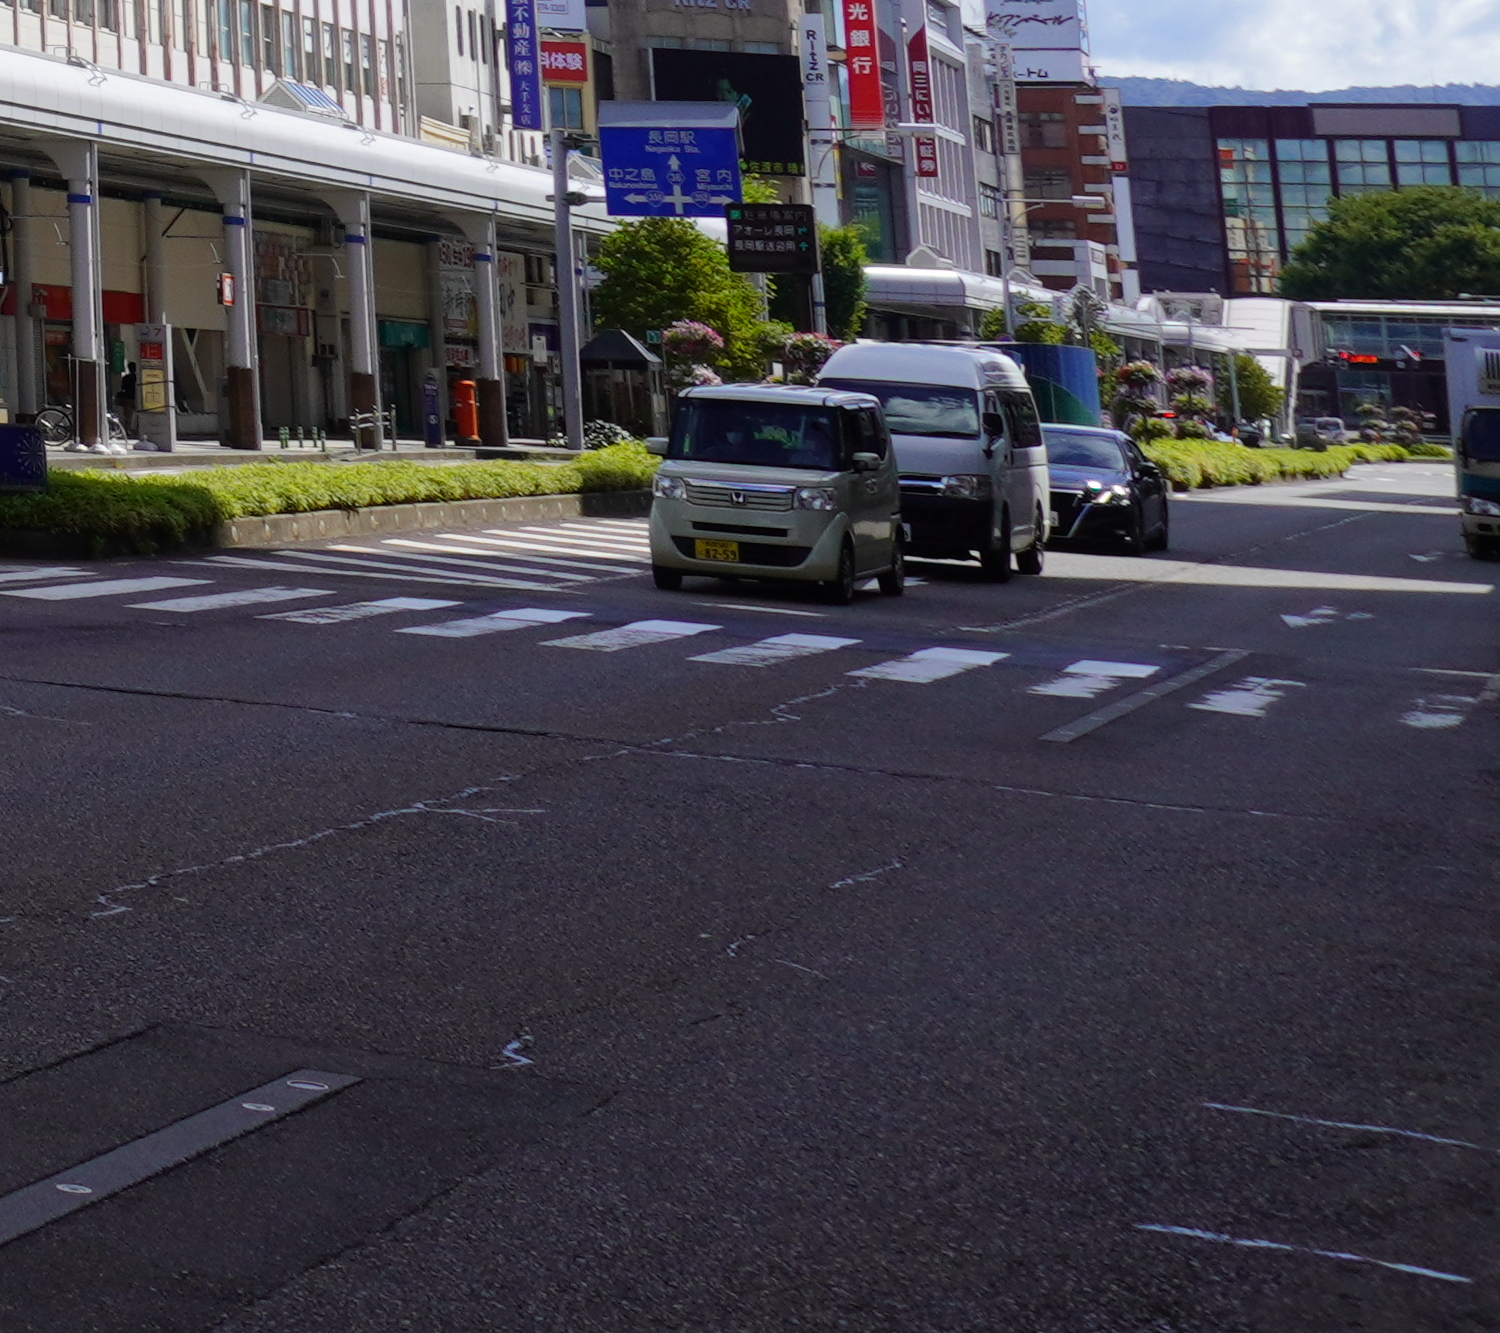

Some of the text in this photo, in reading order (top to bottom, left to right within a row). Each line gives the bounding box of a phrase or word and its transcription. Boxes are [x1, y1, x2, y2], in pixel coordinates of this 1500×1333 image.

[805, 72, 824, 82] CR
[647, 130, 696, 144] 長岡駅
[644, 145, 680, 154] Nagaoka
[608, 168, 656, 181] 中之島
[695, 168, 732, 182] 宮内
[733, 224, 796, 236] アオーレ長岡
